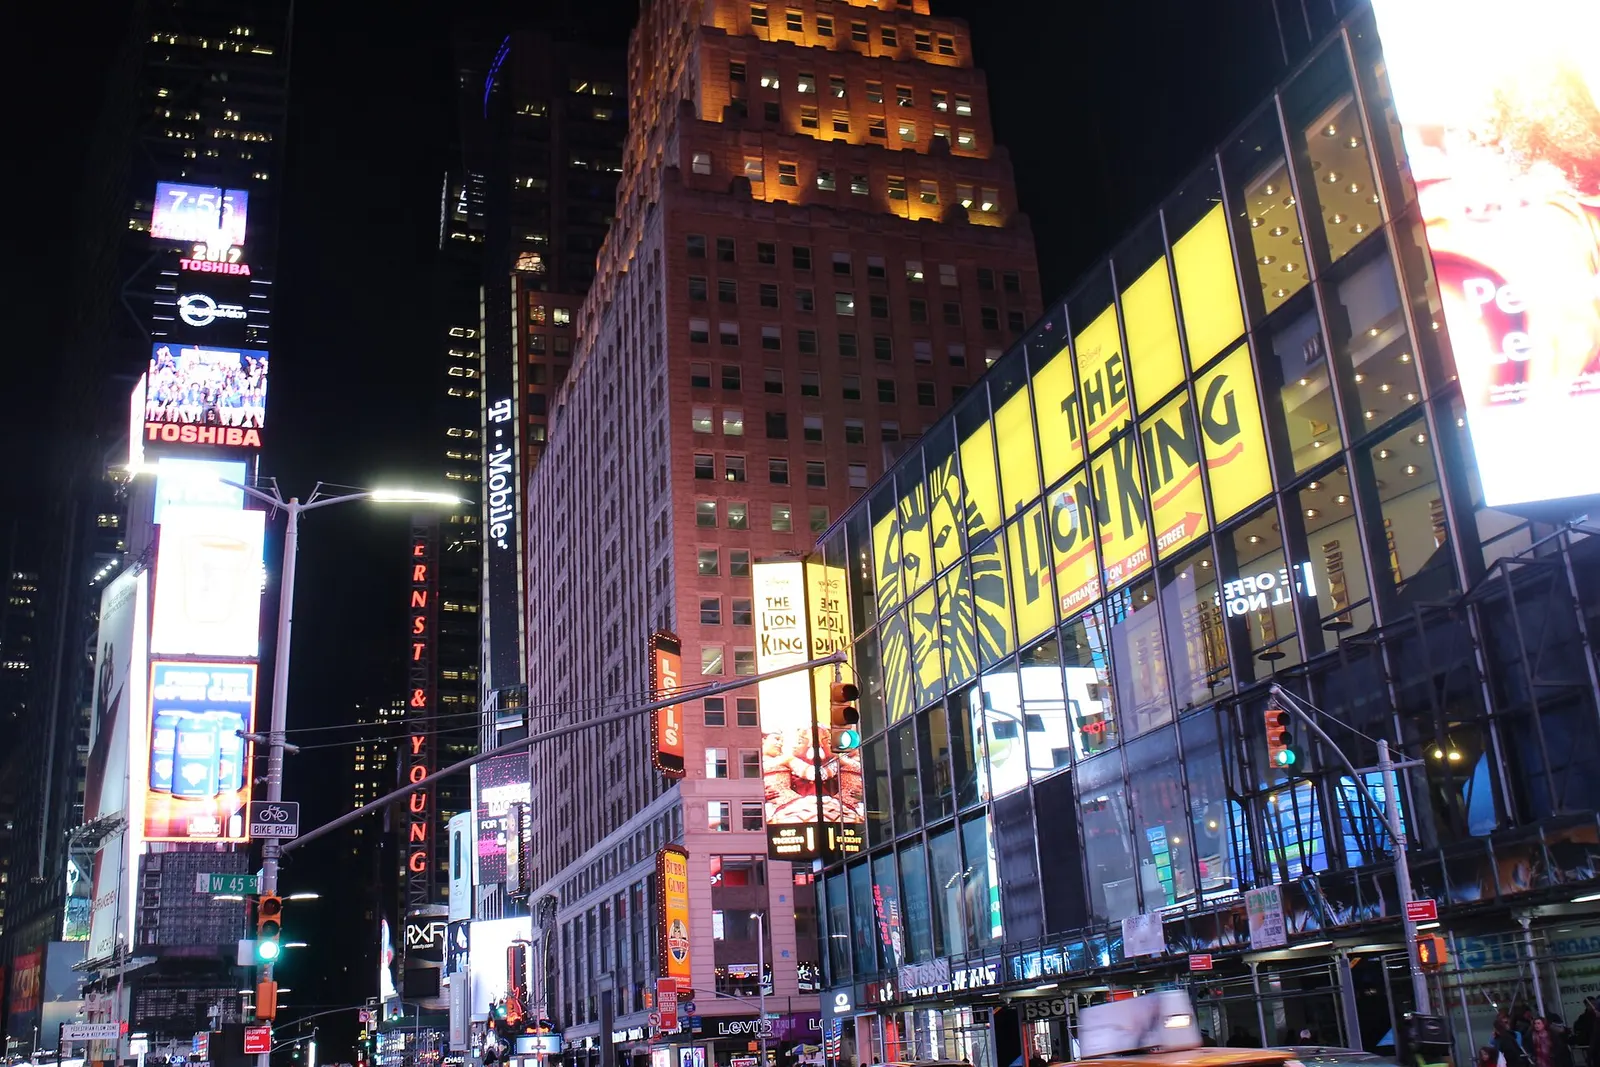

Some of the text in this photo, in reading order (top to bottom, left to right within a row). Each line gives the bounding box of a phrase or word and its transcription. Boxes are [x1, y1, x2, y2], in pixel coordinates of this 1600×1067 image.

[169, 190, 234, 216] 7:55
[180, 259, 251, 276] TOSHIBA
[1061, 352, 1126, 442] THE
[145, 422, 261, 447] TOSHIBA
[1015, 374, 1241, 606] LION KING
[1062, 523, 1186, 610] ENTRANCE ON 45TH STREET
[766, 597, 789, 608] THE
[762, 611, 796, 631] LION
[761, 633, 803, 656] KING
[410, 689, 427, 707] &
[409, 736, 427, 872] YOUNG
[254, 825, 293, 835] BIKE PATH
[481, 819, 497, 830] FOR
[665, 859, 686, 876] BUBBA
[212, 876, 224, 891] W
[229, 877, 244, 892] 45
[667, 877, 686, 893] GUMP
